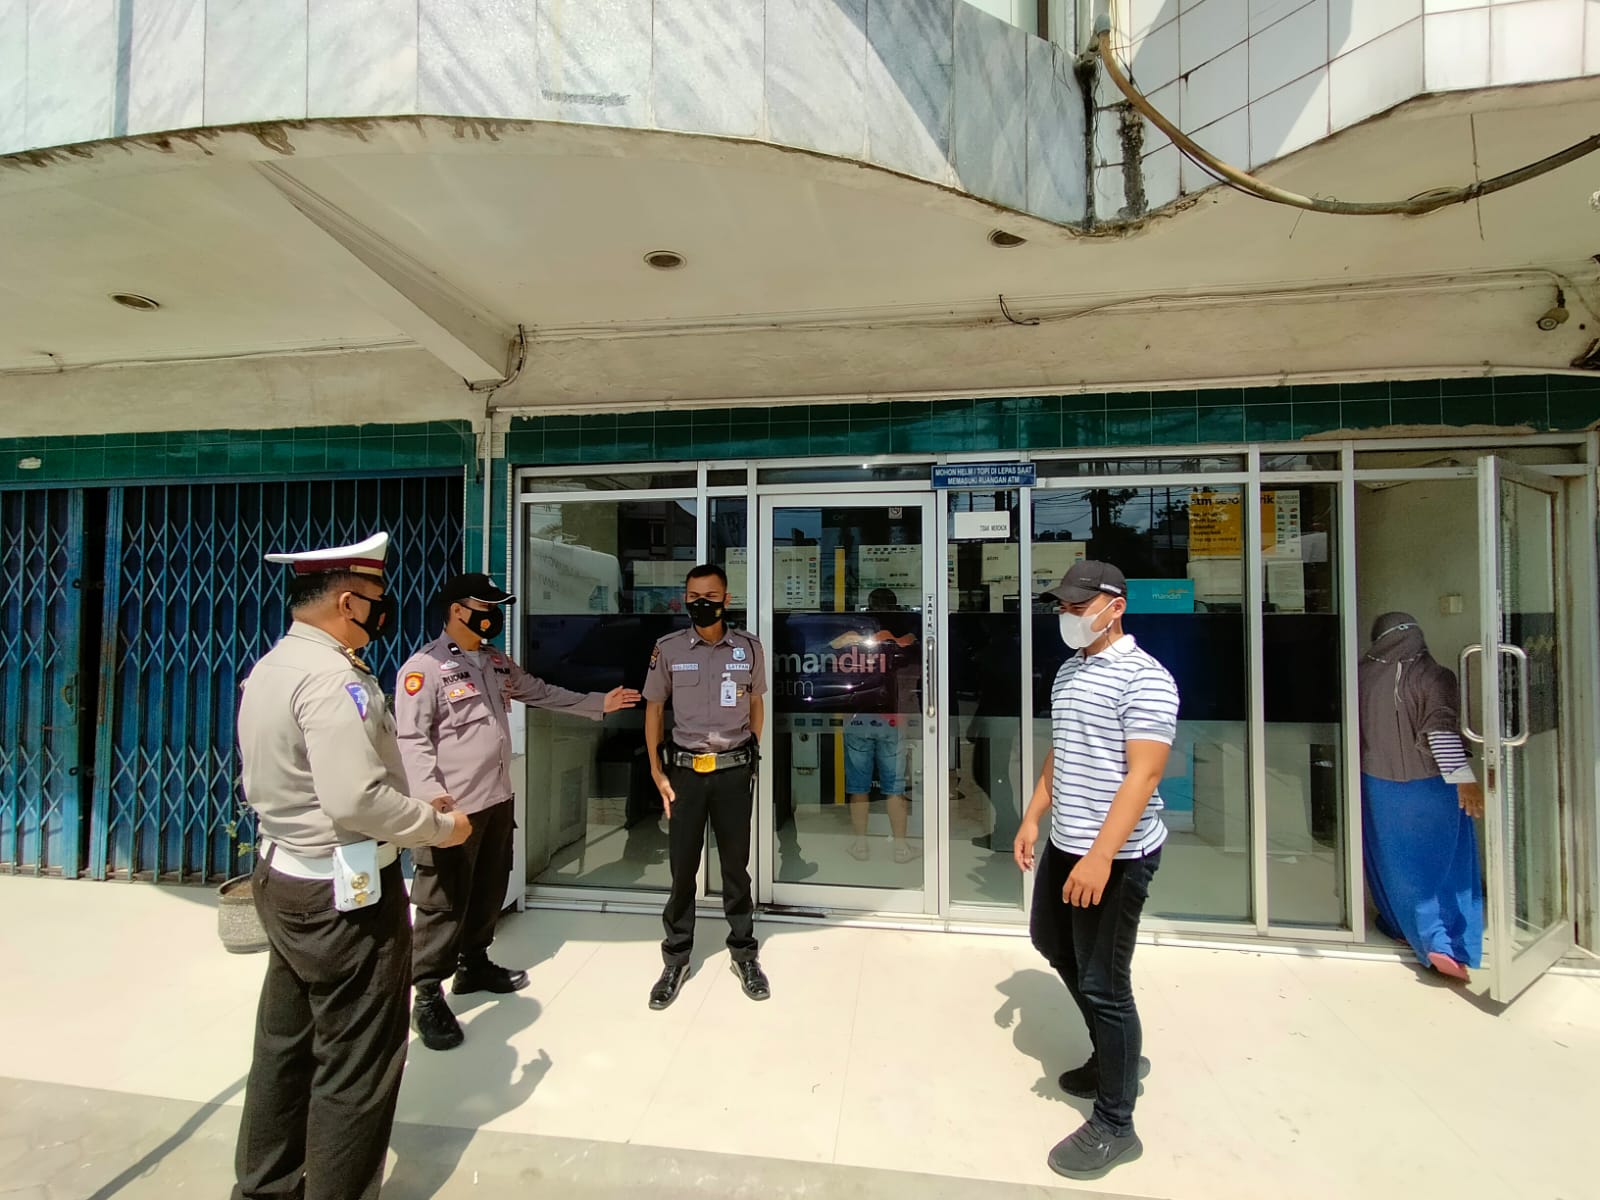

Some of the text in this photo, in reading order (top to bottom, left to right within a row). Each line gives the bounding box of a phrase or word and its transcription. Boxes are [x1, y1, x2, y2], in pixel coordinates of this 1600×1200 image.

[935, 468, 956, 476] MOHON
[957, 467, 973, 476] HELM
[977, 467, 989, 476] TOPI
[990, 467, 997, 475] DI
[997, 466, 1016, 475] LEPAS
[1017, 466, 1032, 474] SAAT
[947, 475, 1020, 485] MEMASUKI RUANGAN ATM
[926, 595, 934, 629] TARIK
[773, 645, 887, 673] mandiri
[775, 678, 814, 696] atm
